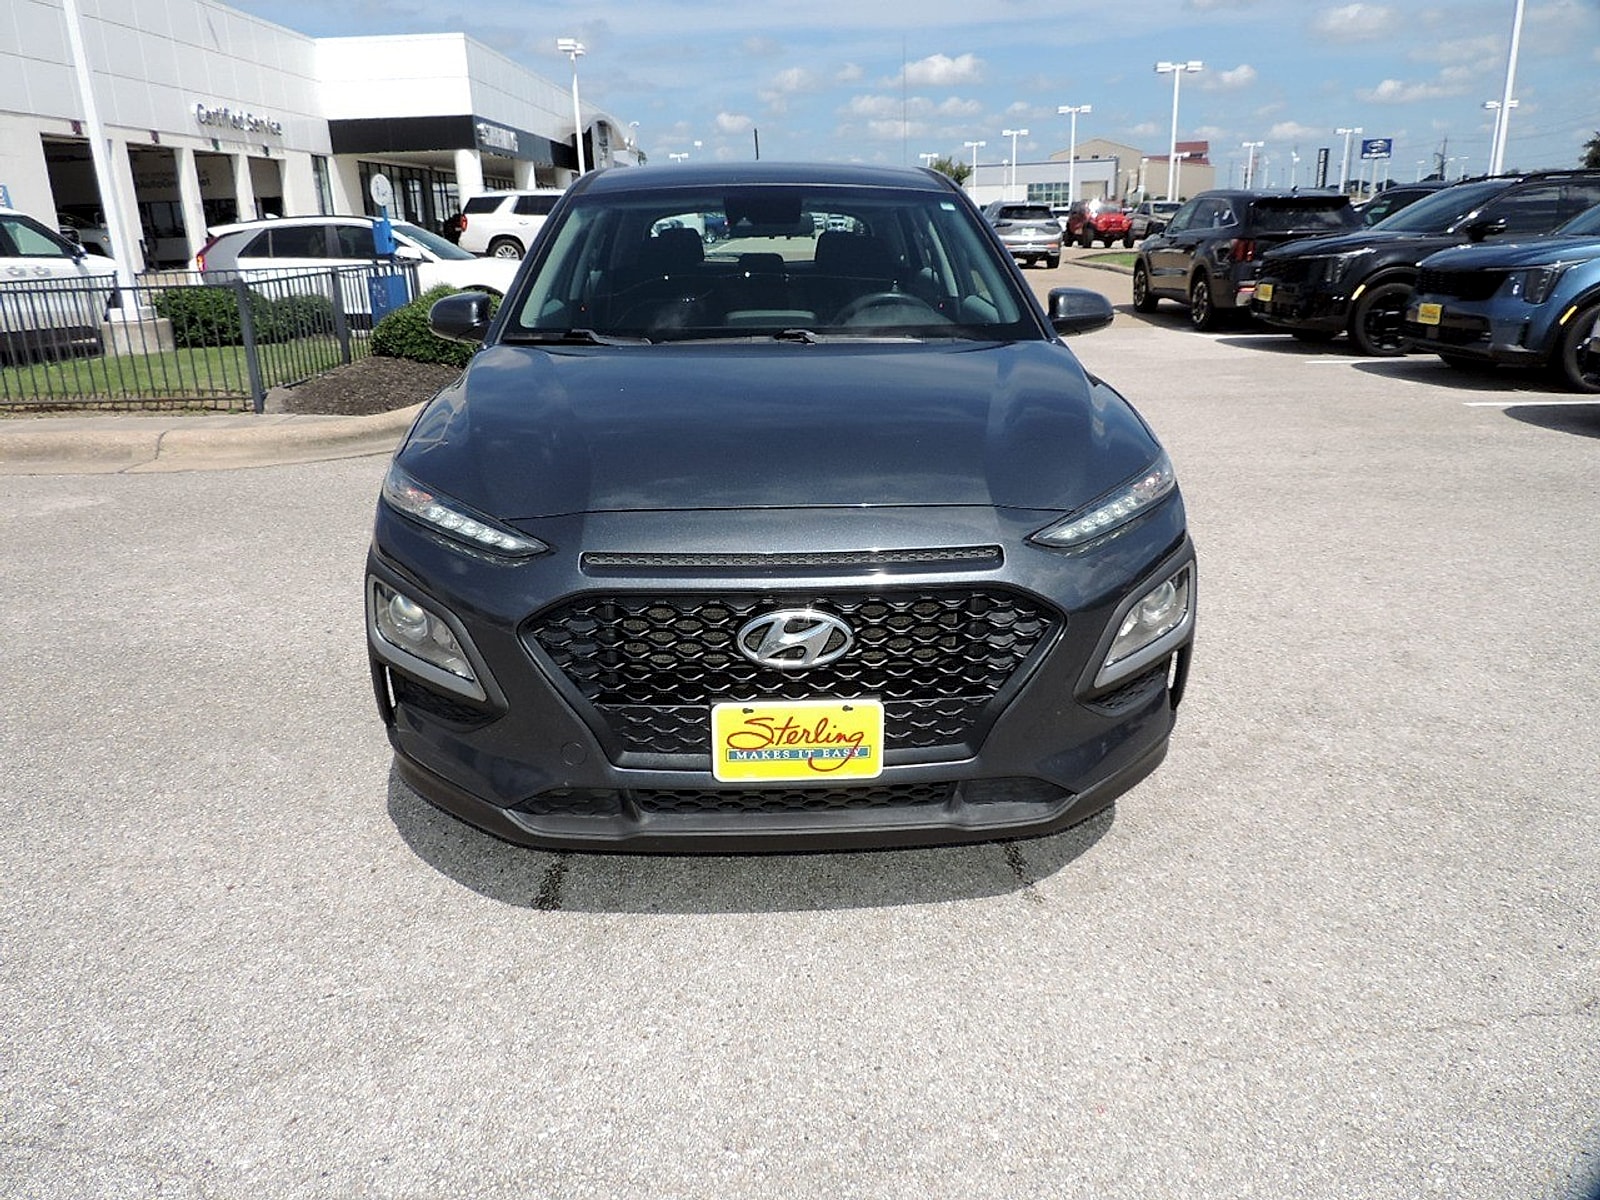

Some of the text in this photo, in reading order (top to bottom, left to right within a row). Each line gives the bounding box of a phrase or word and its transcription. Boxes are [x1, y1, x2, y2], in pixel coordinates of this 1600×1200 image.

[195, 102, 282, 136] Certified Service
[727, 716, 864, 772] Sterling
[736, 748, 861, 760] MAKES IT EASY
